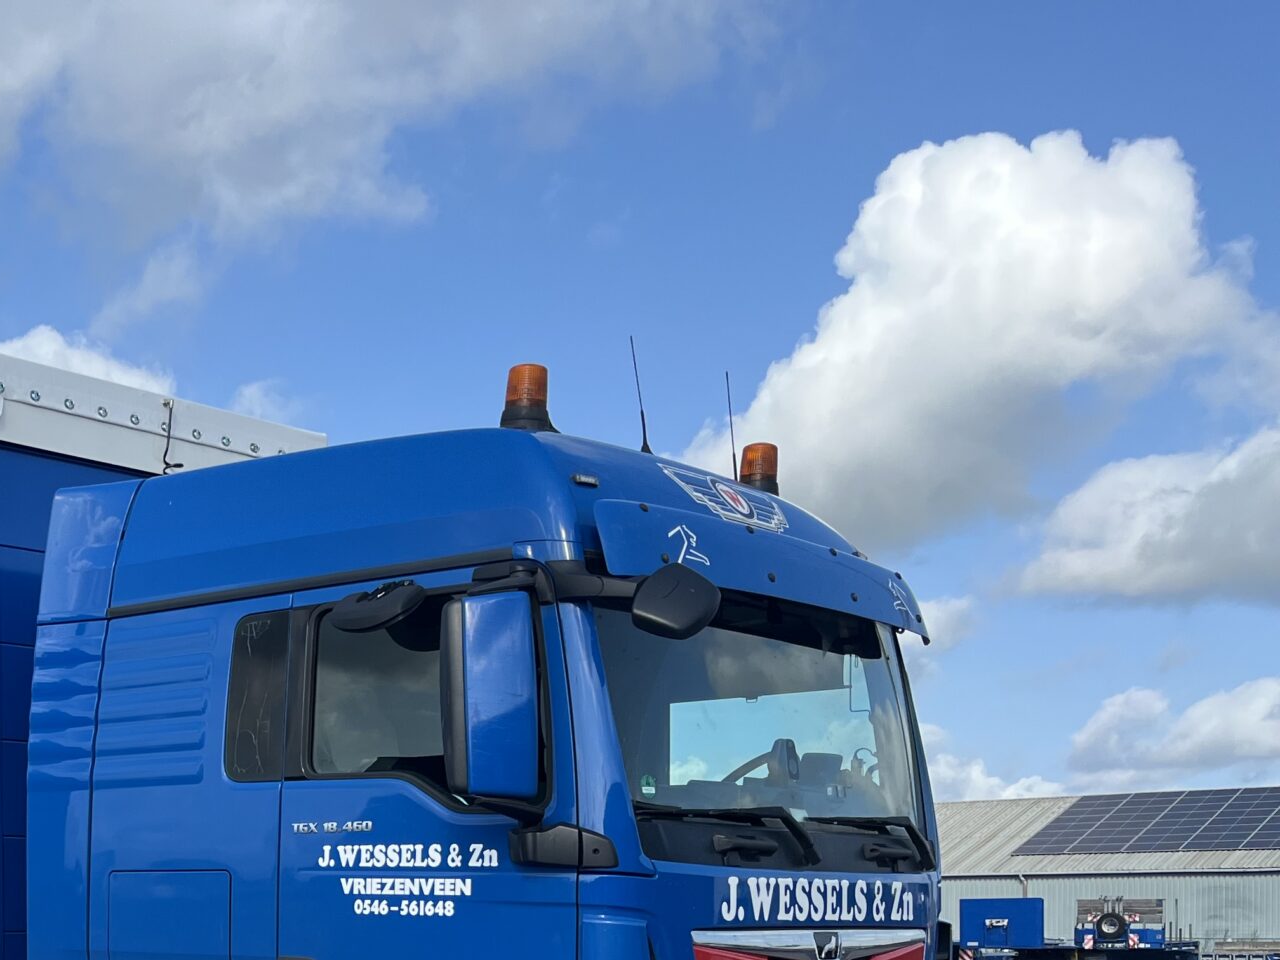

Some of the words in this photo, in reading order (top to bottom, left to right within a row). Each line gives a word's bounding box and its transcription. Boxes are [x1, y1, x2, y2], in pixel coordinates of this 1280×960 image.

[291, 822, 318, 833] TGX
[447, 844, 462, 868] &
[468, 843, 499, 867] Zn
[341, 877, 471, 896] VRIEZENVEEN
[354, 898, 455, 917] 0546-561648
[872, 879, 886, 922] &
[890, 880, 914, 921] Zn
